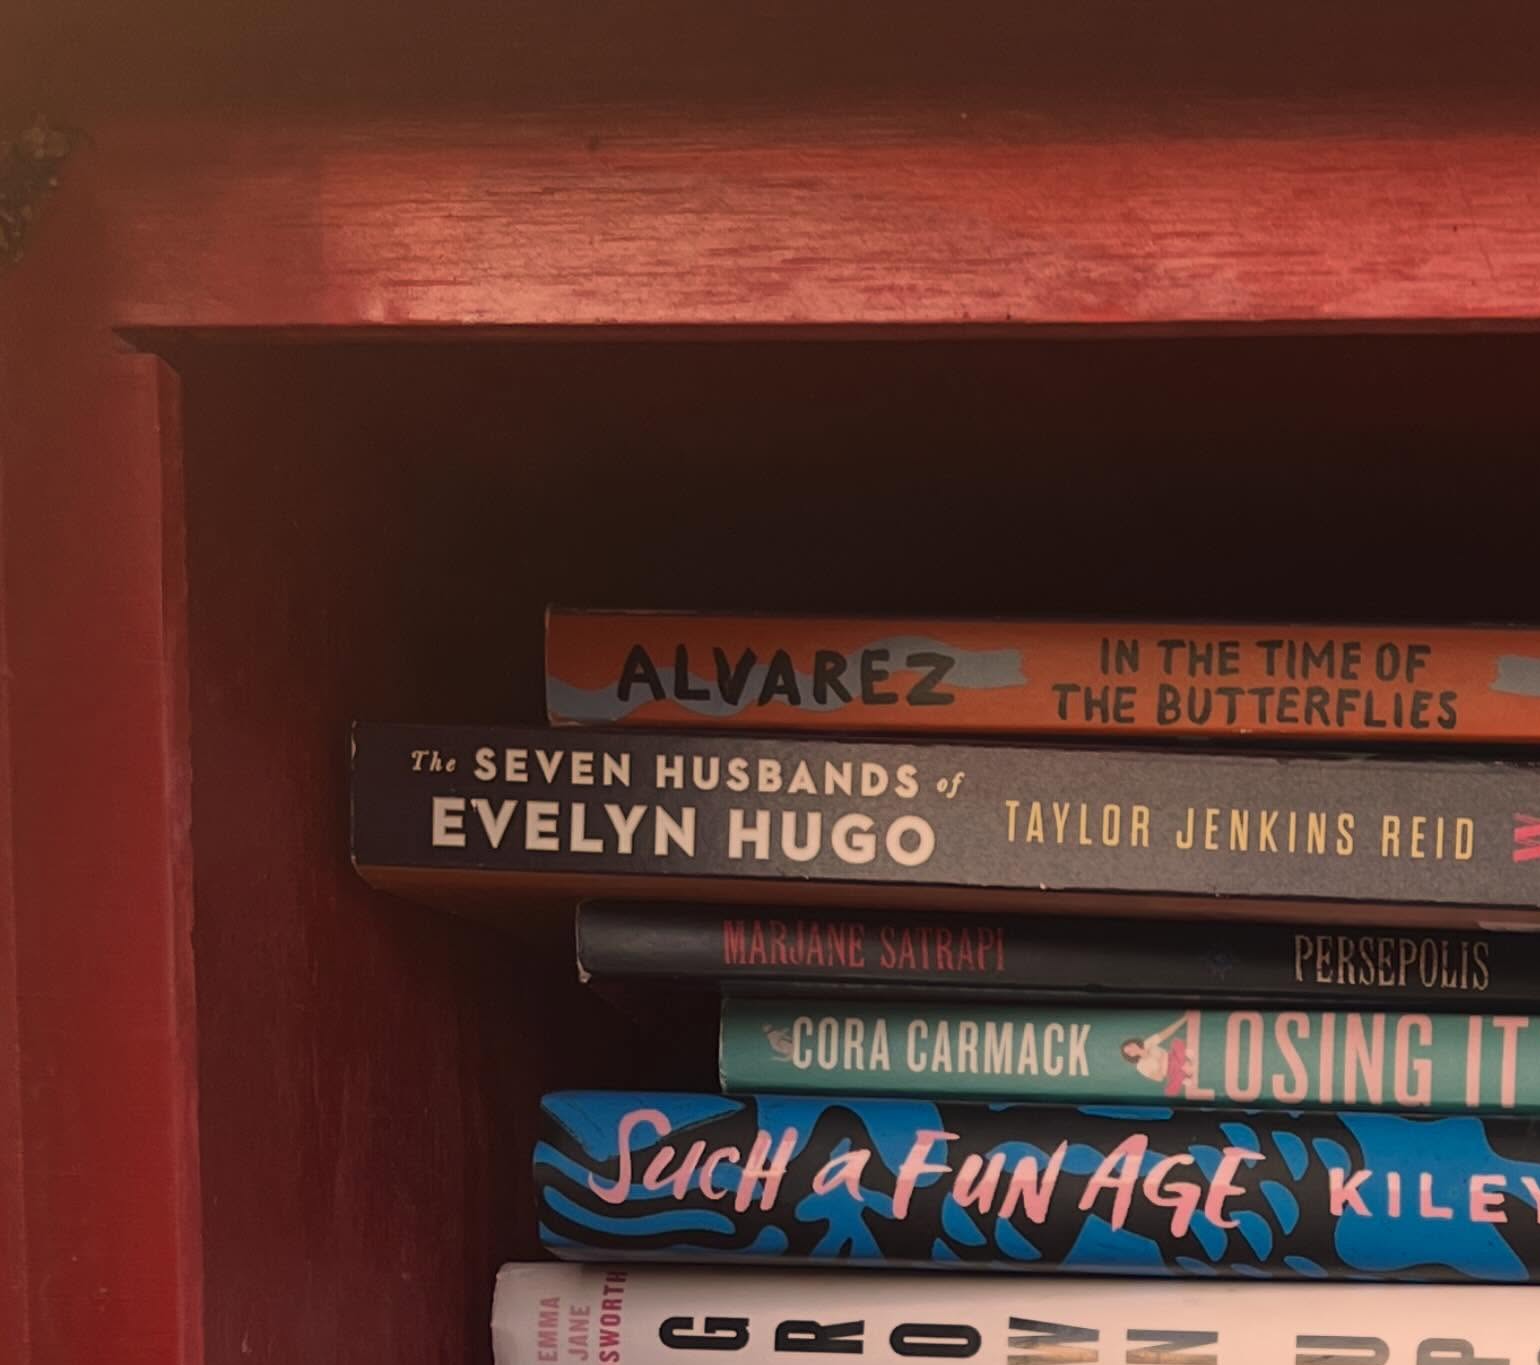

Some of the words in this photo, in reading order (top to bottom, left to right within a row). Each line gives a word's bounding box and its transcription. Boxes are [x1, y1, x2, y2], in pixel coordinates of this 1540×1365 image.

[617, 644, 956, 707] ALVAREZ
[1100, 637, 1140, 675] IN
[1158, 640, 1240, 679] THE
[1255, 639, 1362, 681] TIME
[1375, 643, 1432, 683] OF
[1052, 684, 1136, 724] THE
[1157, 685, 1458, 731] BUTTERFLIES
[410, 750, 457, 774] The
[474, 747, 632, 788] SEVEN
[655, 756, 919, 799] HUSBANDS
[936, 772, 965, 797] of
[432, 797, 697, 858] EVELYN
[727, 809, 936, 867] HUGO
[1005, 799, 1152, 849] TAYLOR
[1176, 809, 1355, 857] JENKINS
[1382, 814, 1476, 862] REID
[1294, 935, 1491, 992] PERSEPOLIS
[791, 1016, 891, 1073] CORA
[906, 1019, 1091, 1078] CARMACK
[536, 1295, 561, 1363] EMMA
[568, 1304, 591, 1362] JANE
